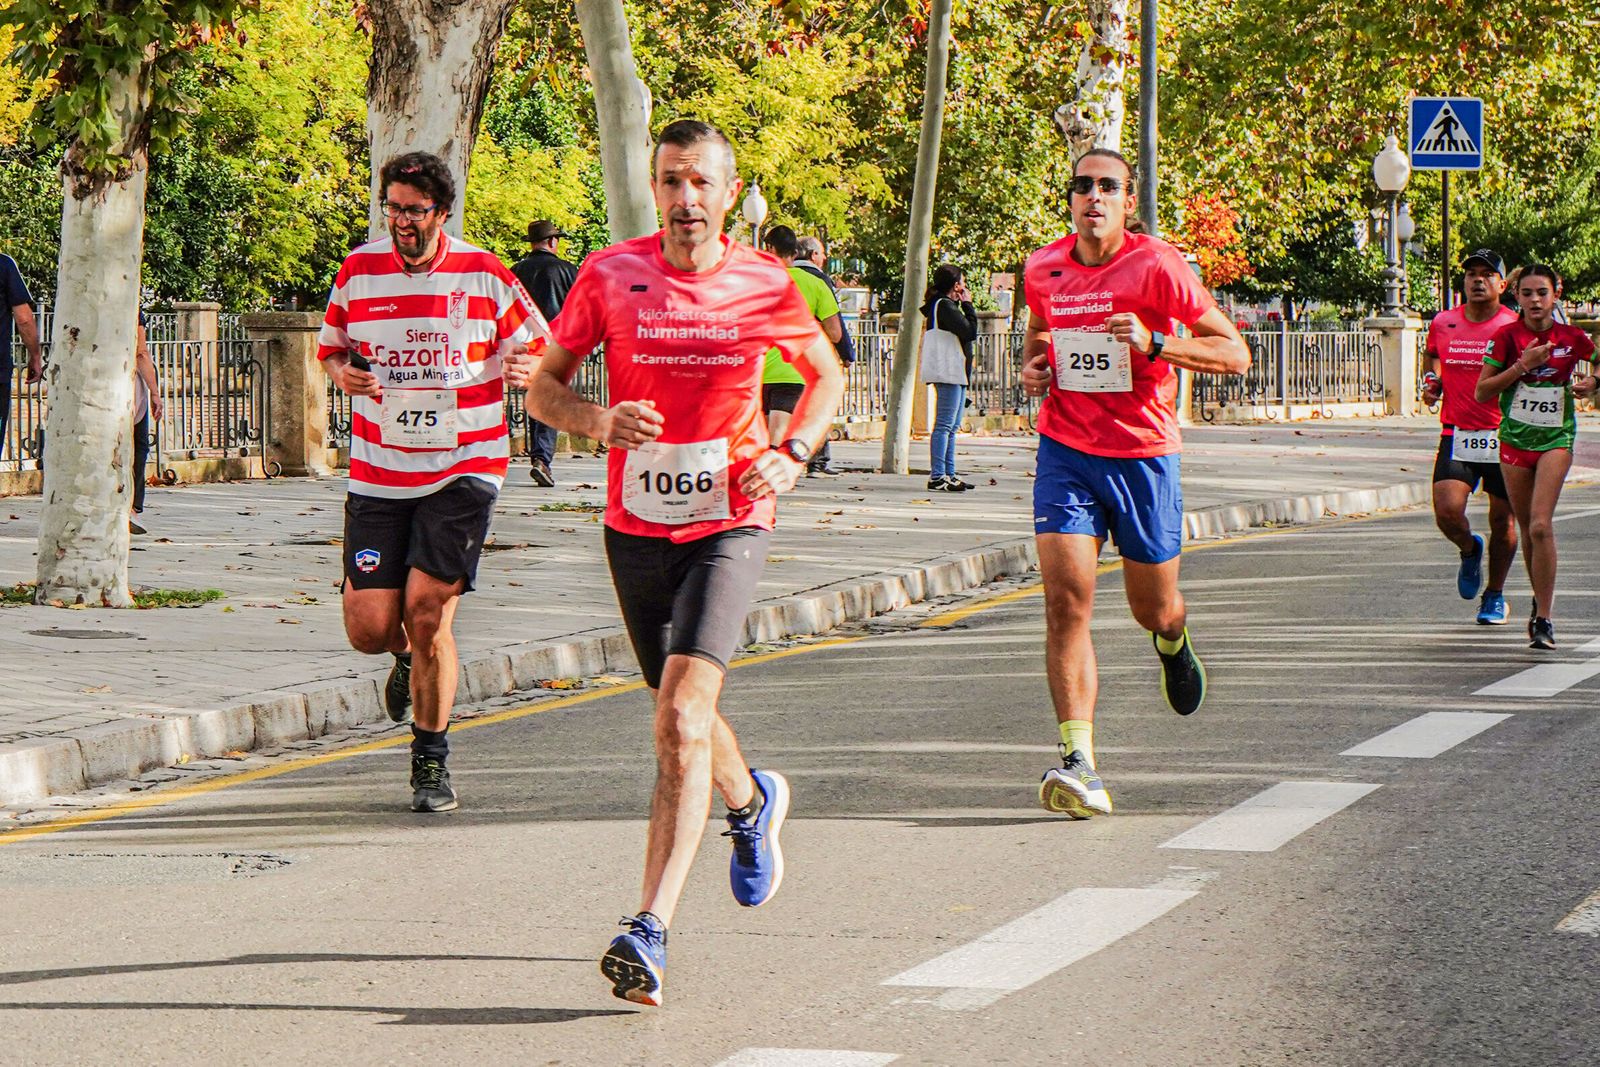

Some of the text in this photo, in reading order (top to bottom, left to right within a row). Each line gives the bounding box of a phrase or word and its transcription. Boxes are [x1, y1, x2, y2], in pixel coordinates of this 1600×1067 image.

[1100, 290, 1113, 299] de
[638, 308, 739, 322] kilómetros de
[1051, 301, 1113, 316] humanidad
[406, 329, 449, 343] Sierra
[637, 324, 739, 340] humanidad
[375, 344, 462, 368] Cazorla
[1449, 346, 1485, 354] humanid
[632, 354, 745, 367] #CarreraCruzRoja
[1070, 352, 1110, 371] 295
[388, 368, 464, 384] Agua Mineral
[1520, 399, 1558, 413] 1763
[396, 410, 438, 427] 475
[1462, 438, 1498, 450] 1893
[639, 470, 713, 495] 1066
